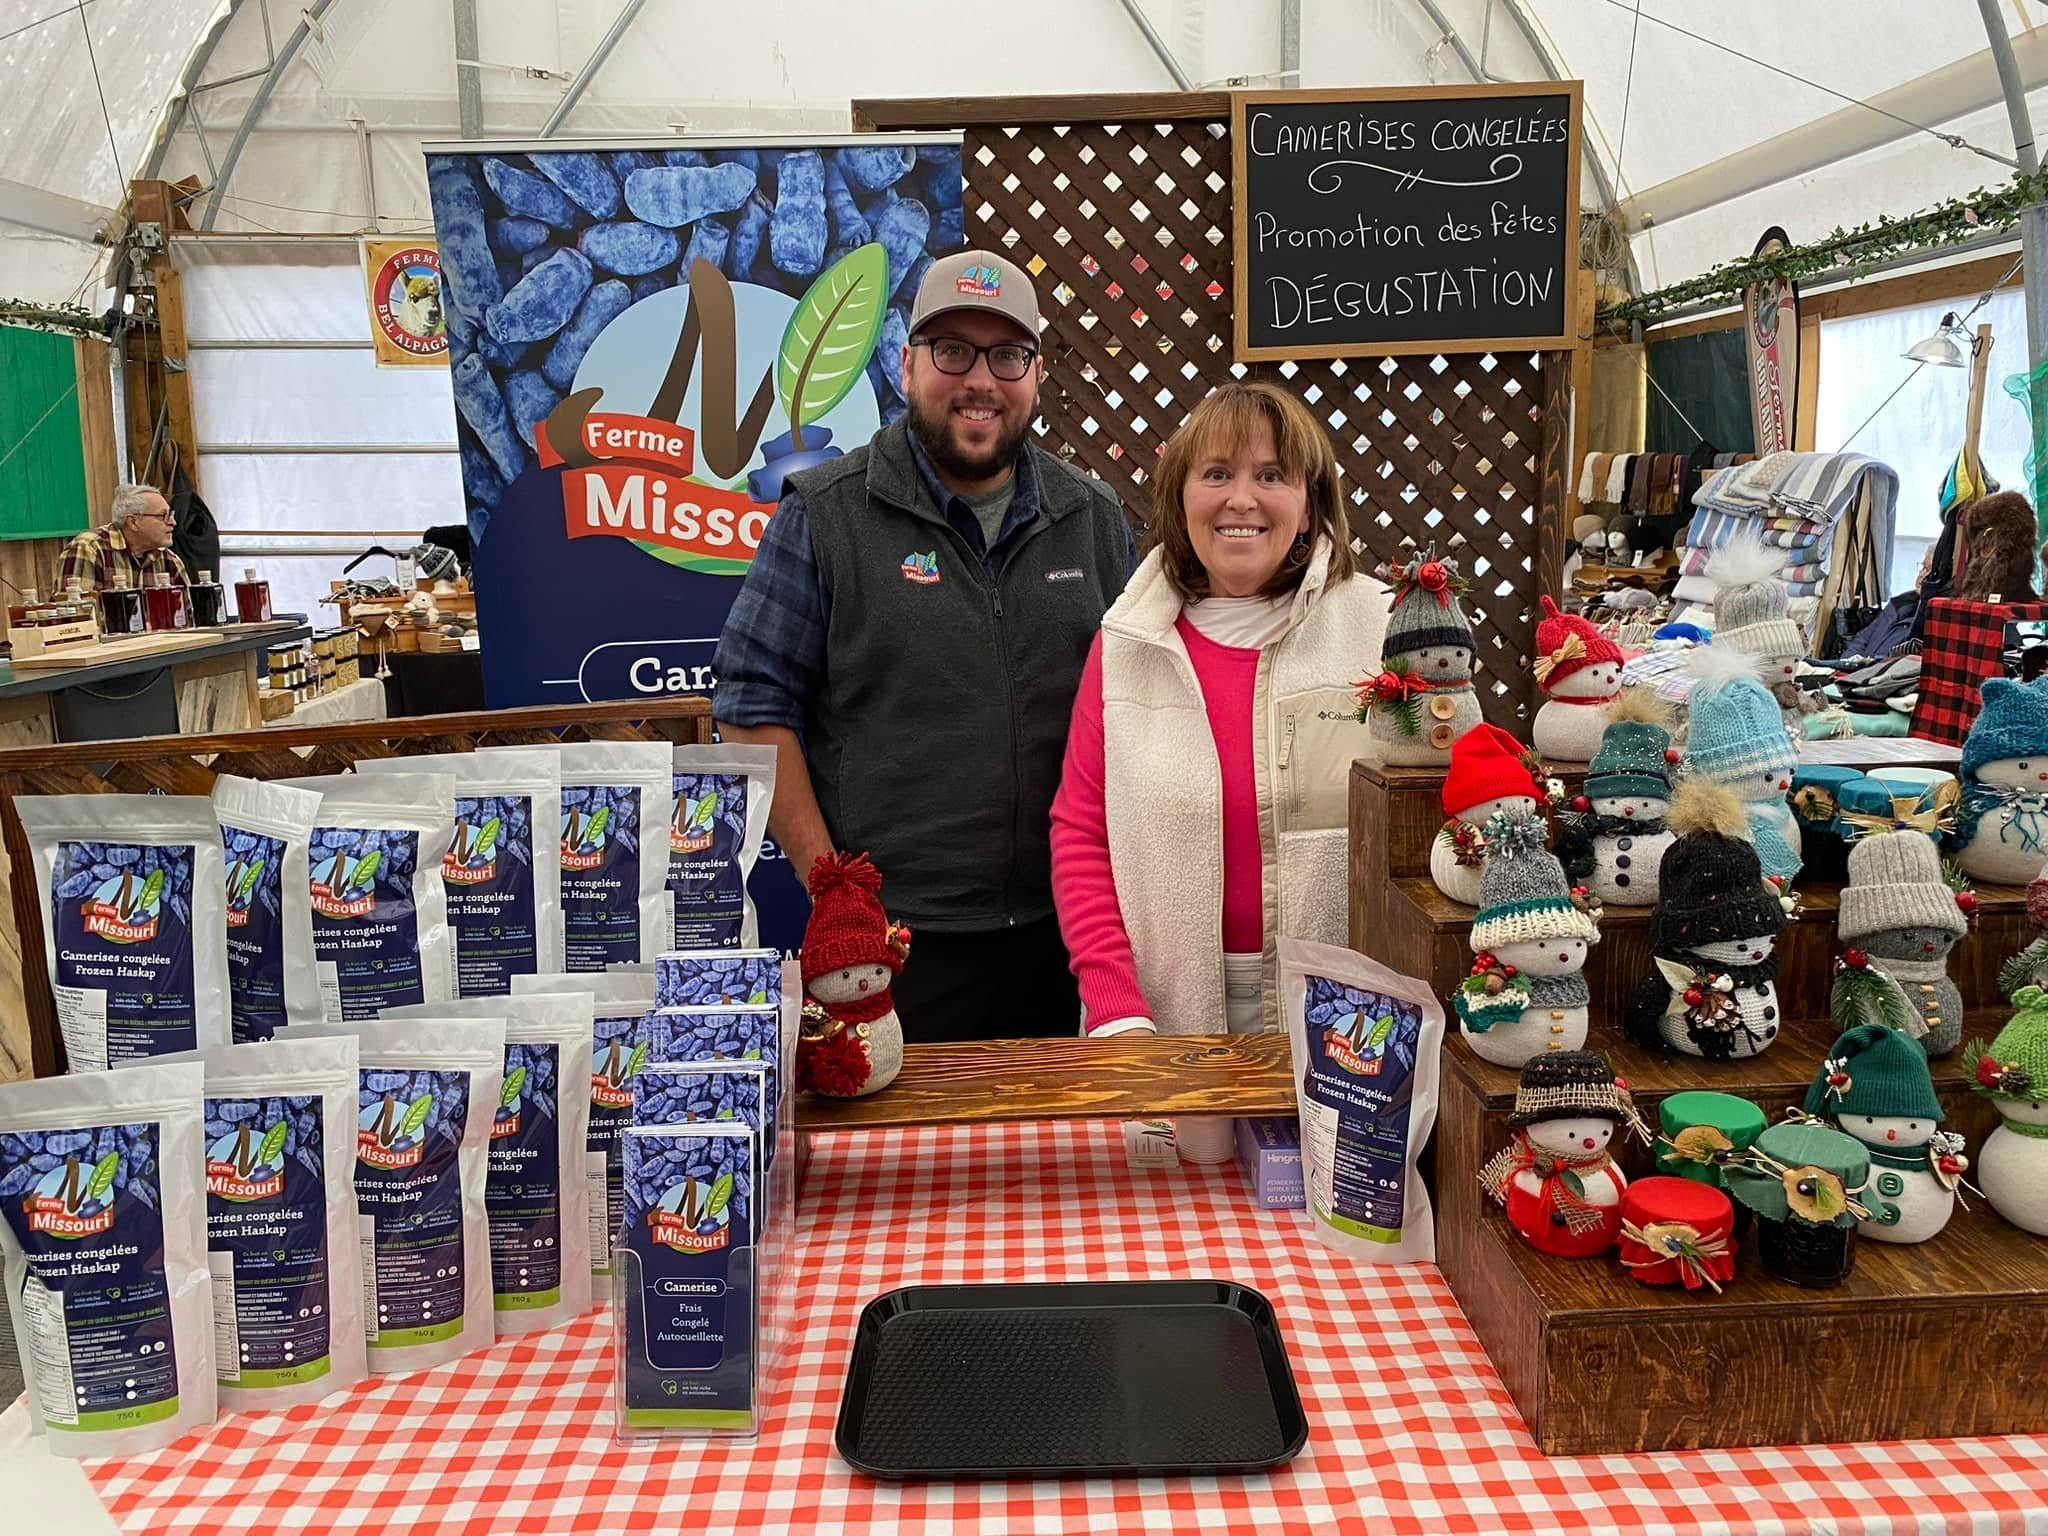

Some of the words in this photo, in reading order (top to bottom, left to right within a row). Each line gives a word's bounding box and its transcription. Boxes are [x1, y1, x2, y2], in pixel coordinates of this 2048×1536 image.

[1250, 112, 1415, 156] CAMERISES
[1431, 109, 1567, 152] CONGELÉES
[1255, 211, 1424, 252] Promotion
[1438, 211, 1482, 242] des
[1265, 258, 1553, 329] DÉGUSTATION
[379, 304, 394, 333] BEL
[394, 336, 449, 352] ALPAGA
[586, 422, 684, 457] Ferme
[684, 859, 729, 870] congelées
[680, 871, 716, 880] Haskap
[574, 878, 622, 889] congelées
[466, 892, 515, 903] congelées
[571, 890, 608, 901] Haskap
[462, 905, 501, 915] Haskap
[88, 916, 154, 938] Missouri
[344, 924, 398, 937] congelées
[341, 938, 382, 948] Haskap
[60, 950, 120, 963] Camerises
[122, 952, 171, 965] congelées
[75, 965, 114, 977] Frozen
[116, 966, 156, 980] Haskap
[1328, 1043, 1379, 1073] Missouri
[1311, 1067, 1350, 1088] Camerises
[1352, 1084, 1392, 1102] congelées
[1317, 1083, 1345, 1099] Frozen
[1347, 1093, 1377, 1112] Haskap
[209, 1164, 234, 1173] Ferme
[206, 1176, 280, 1195] Missouri
[386, 1174, 438, 1190] congelées
[382, 1191, 423, 1203] Haskap
[1267, 1195, 1305, 1203] GLOVES
[246, 1209, 303, 1222] congelées
[659, 1214, 683, 1224] Ferme
[34, 1213, 110, 1232] Missouri
[241, 1224, 287, 1236] Haskap
[657, 1227, 725, 1248] Missouri
[24, 1250, 72, 1262] merises
[75, 1244, 139, 1260] congelées
[71, 1261, 121, 1276] Haskap
[664, 1281, 717, 1293] Camerise
[680, 1303, 702, 1313] Frais
[671, 1317, 710, 1329] Congelé
[657, 1331, 724, 1342] Autocueillette
[117, 1411, 133, 1420] 750
